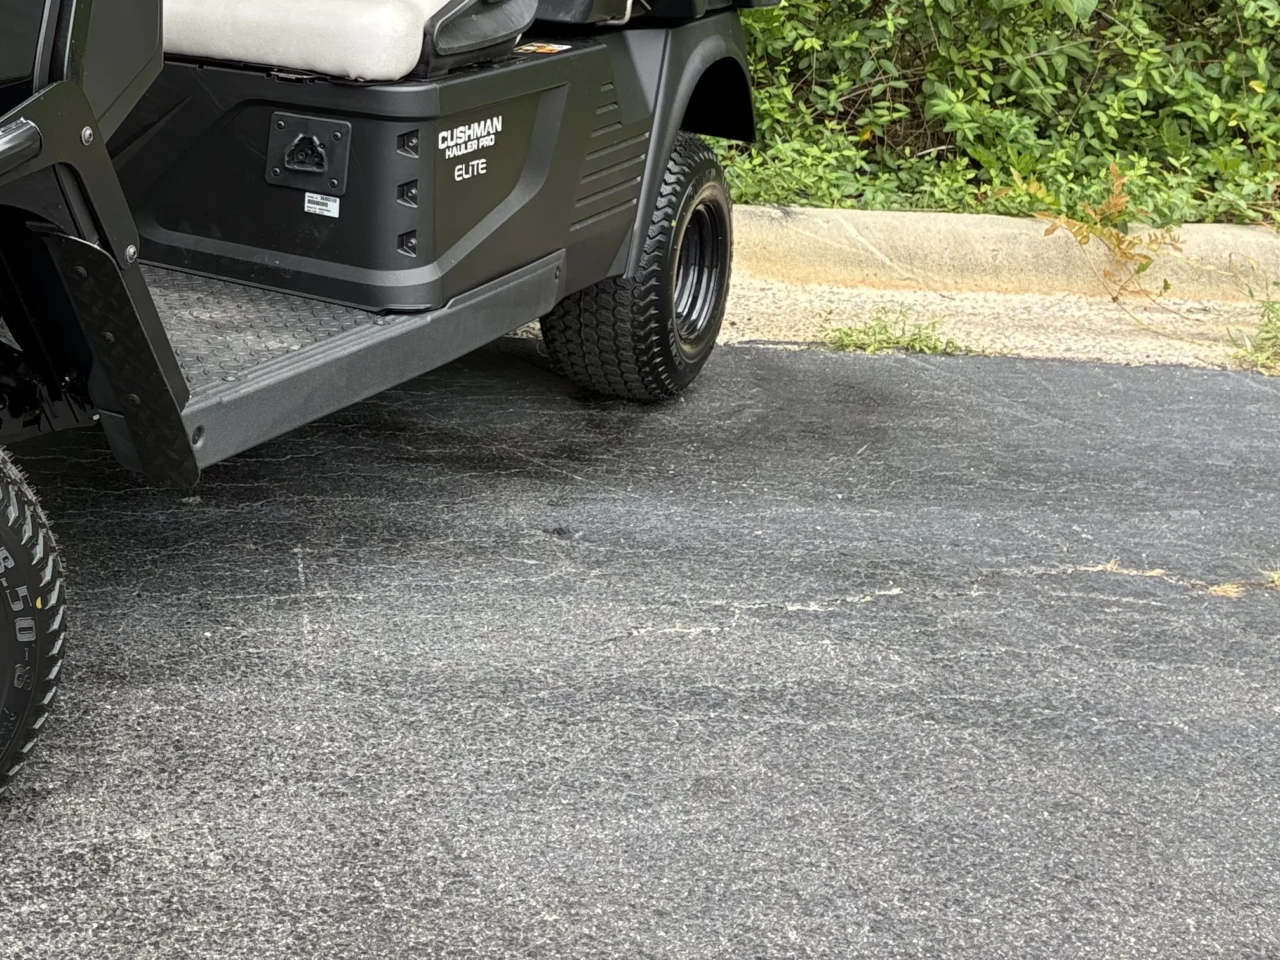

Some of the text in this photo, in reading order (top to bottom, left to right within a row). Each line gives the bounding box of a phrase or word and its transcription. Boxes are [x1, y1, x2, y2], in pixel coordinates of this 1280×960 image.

[438, 115, 503, 150] CUSHMAN
[445, 134, 495, 159] HAULER PRO
